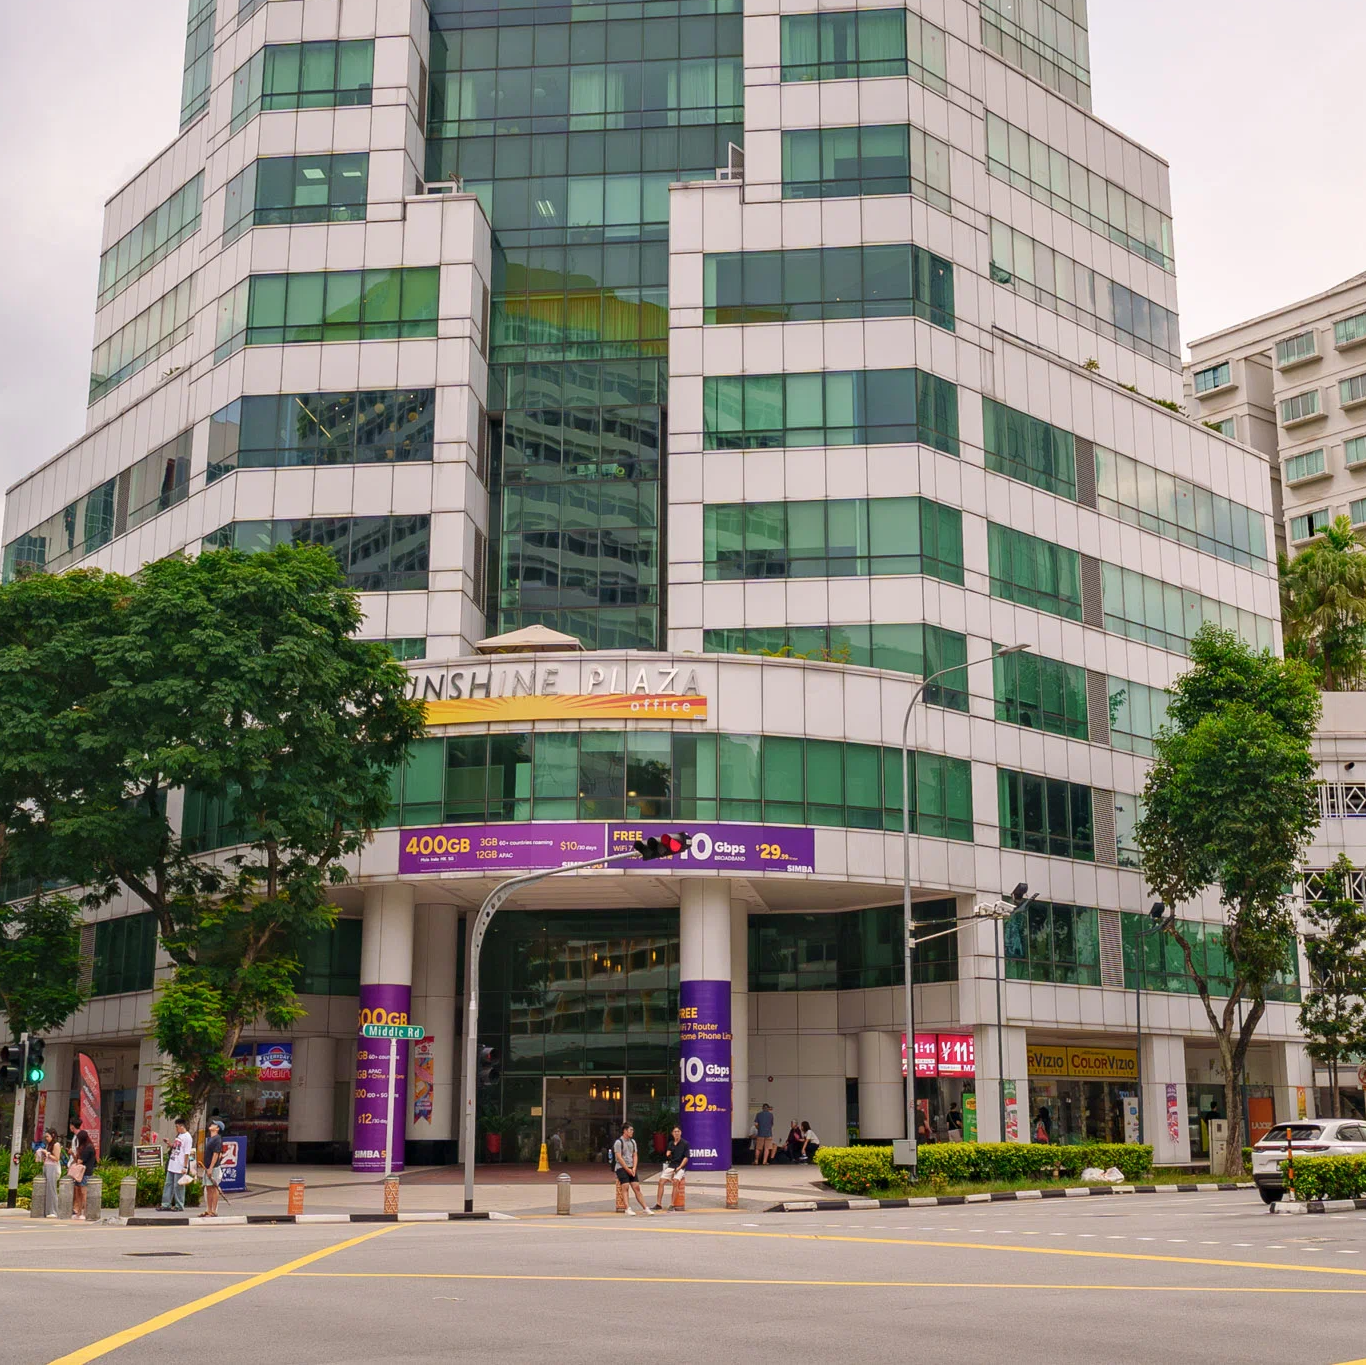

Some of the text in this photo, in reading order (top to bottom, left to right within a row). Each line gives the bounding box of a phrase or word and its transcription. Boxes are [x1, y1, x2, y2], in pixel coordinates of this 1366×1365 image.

[587, 666, 700, 695] PLAZA
[630, 698, 691, 712] office
[613, 830, 643, 841] FREE
[405, 835, 470, 855] 400GB
[480, 838, 498, 847] 3GB
[714, 841, 746, 854] Gbps
[475, 850, 498, 859] 12GB
[787, 864, 815, 874] SIMBA
[692, 1022, 718, 1030] Router
[369, 1026, 420, 1038] Middle Rd
[698, 1031, 721, 1040] Phone
[679, 1056, 729, 1083] 10 Gbps
[354, 1150, 380, 1159] SIMBA
[689, 1149, 718, 1158] SIMBA
